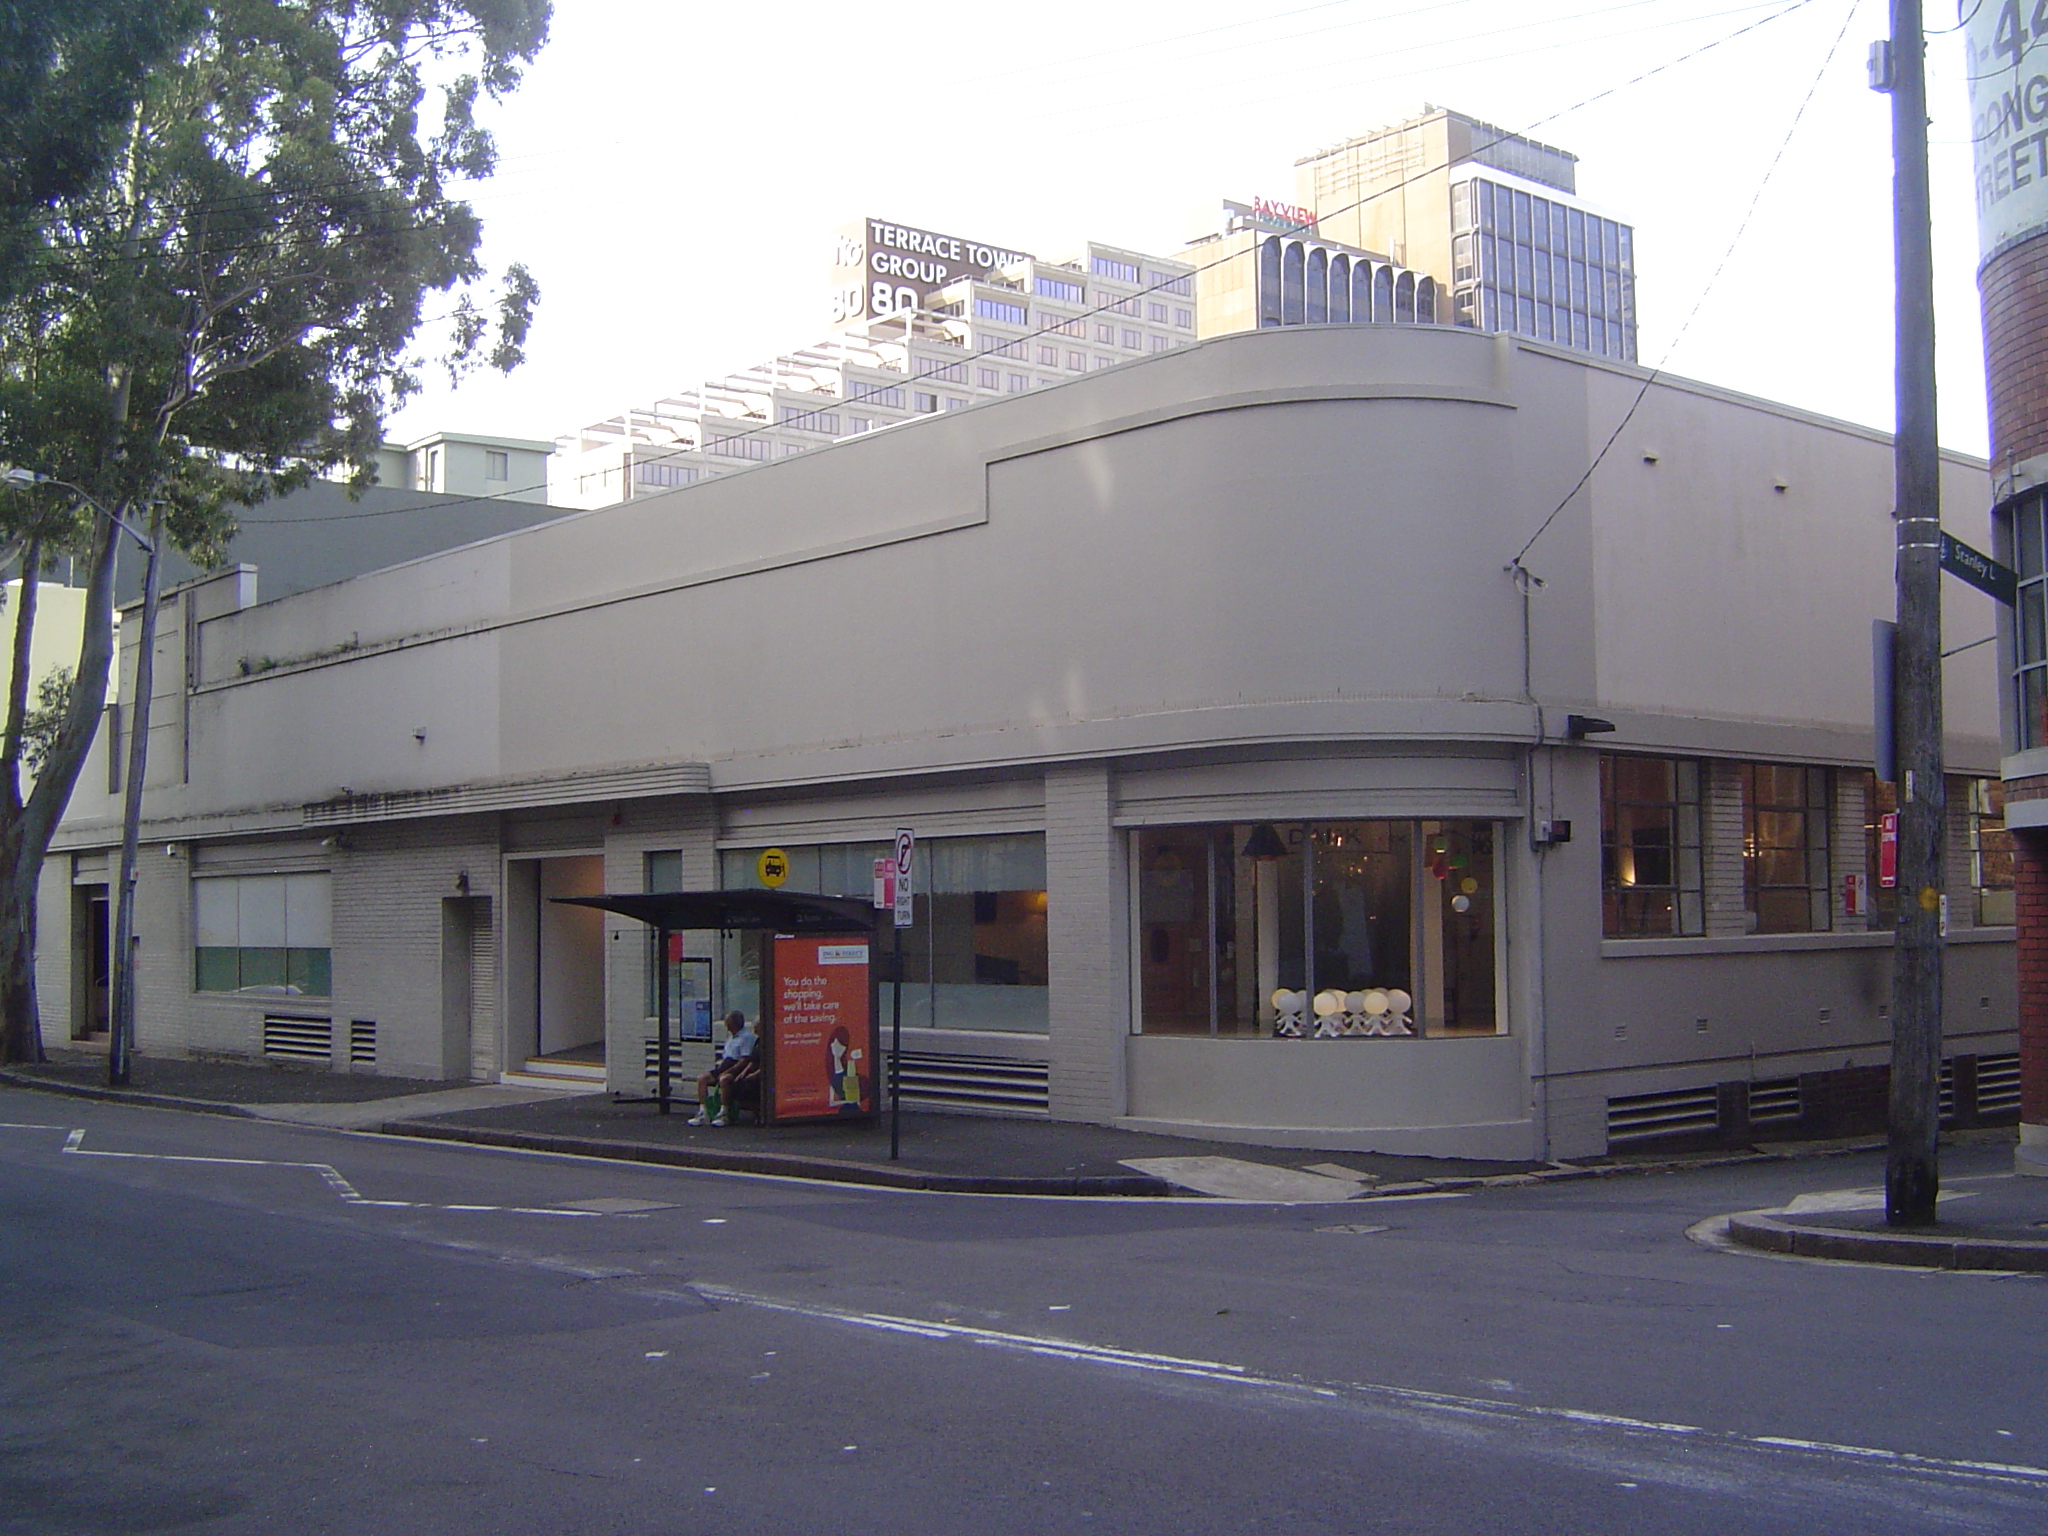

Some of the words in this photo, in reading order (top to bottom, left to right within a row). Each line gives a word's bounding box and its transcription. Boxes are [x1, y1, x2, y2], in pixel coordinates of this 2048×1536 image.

[1255, 196, 1318, 226] BAYVIEW
[870, 221, 961, 261] TERRACE
[870, 251, 948, 284] GROUP
[871, 280, 919, 318] 80
[1955, 544, 1988, 578] Stanley
[898, 877, 908, 892] NO
[784, 977, 799, 985] You
[801, 977, 812, 985] do
[814, 976, 827, 985] the
[784, 989, 823, 1001] shopping,
[804, 1001, 820, 1010] take
[784, 1014, 792, 1023] of
[795, 1014, 808, 1023] the
